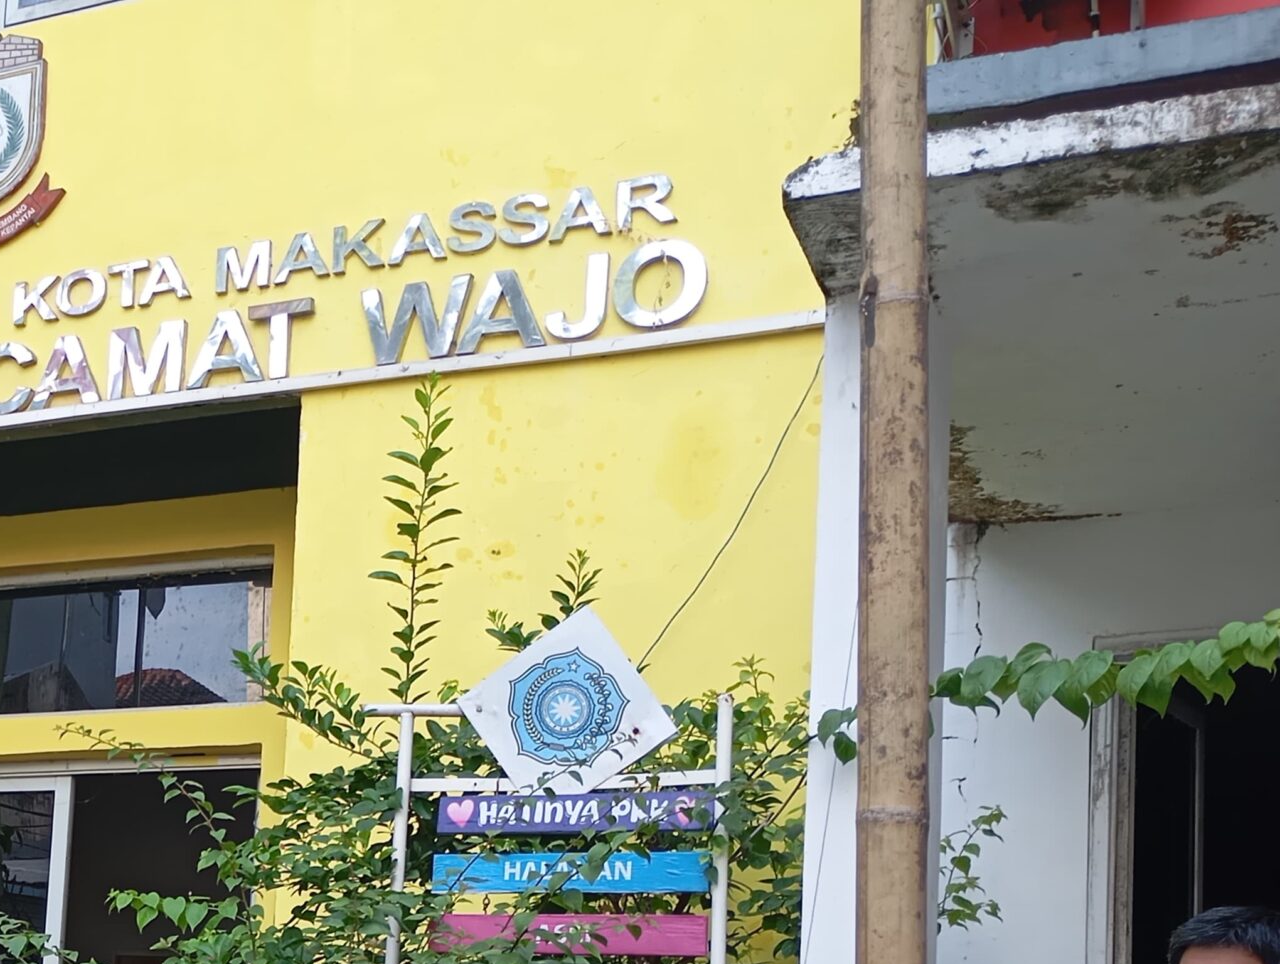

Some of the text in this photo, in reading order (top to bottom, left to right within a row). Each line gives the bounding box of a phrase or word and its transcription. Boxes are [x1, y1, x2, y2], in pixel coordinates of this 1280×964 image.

[13, 255, 191, 327] KOTA
[215, 174, 678, 295] MAKASSAR
[361, 238, 708, 366] WAJO
[504, 861, 632, 880] HALAAN
